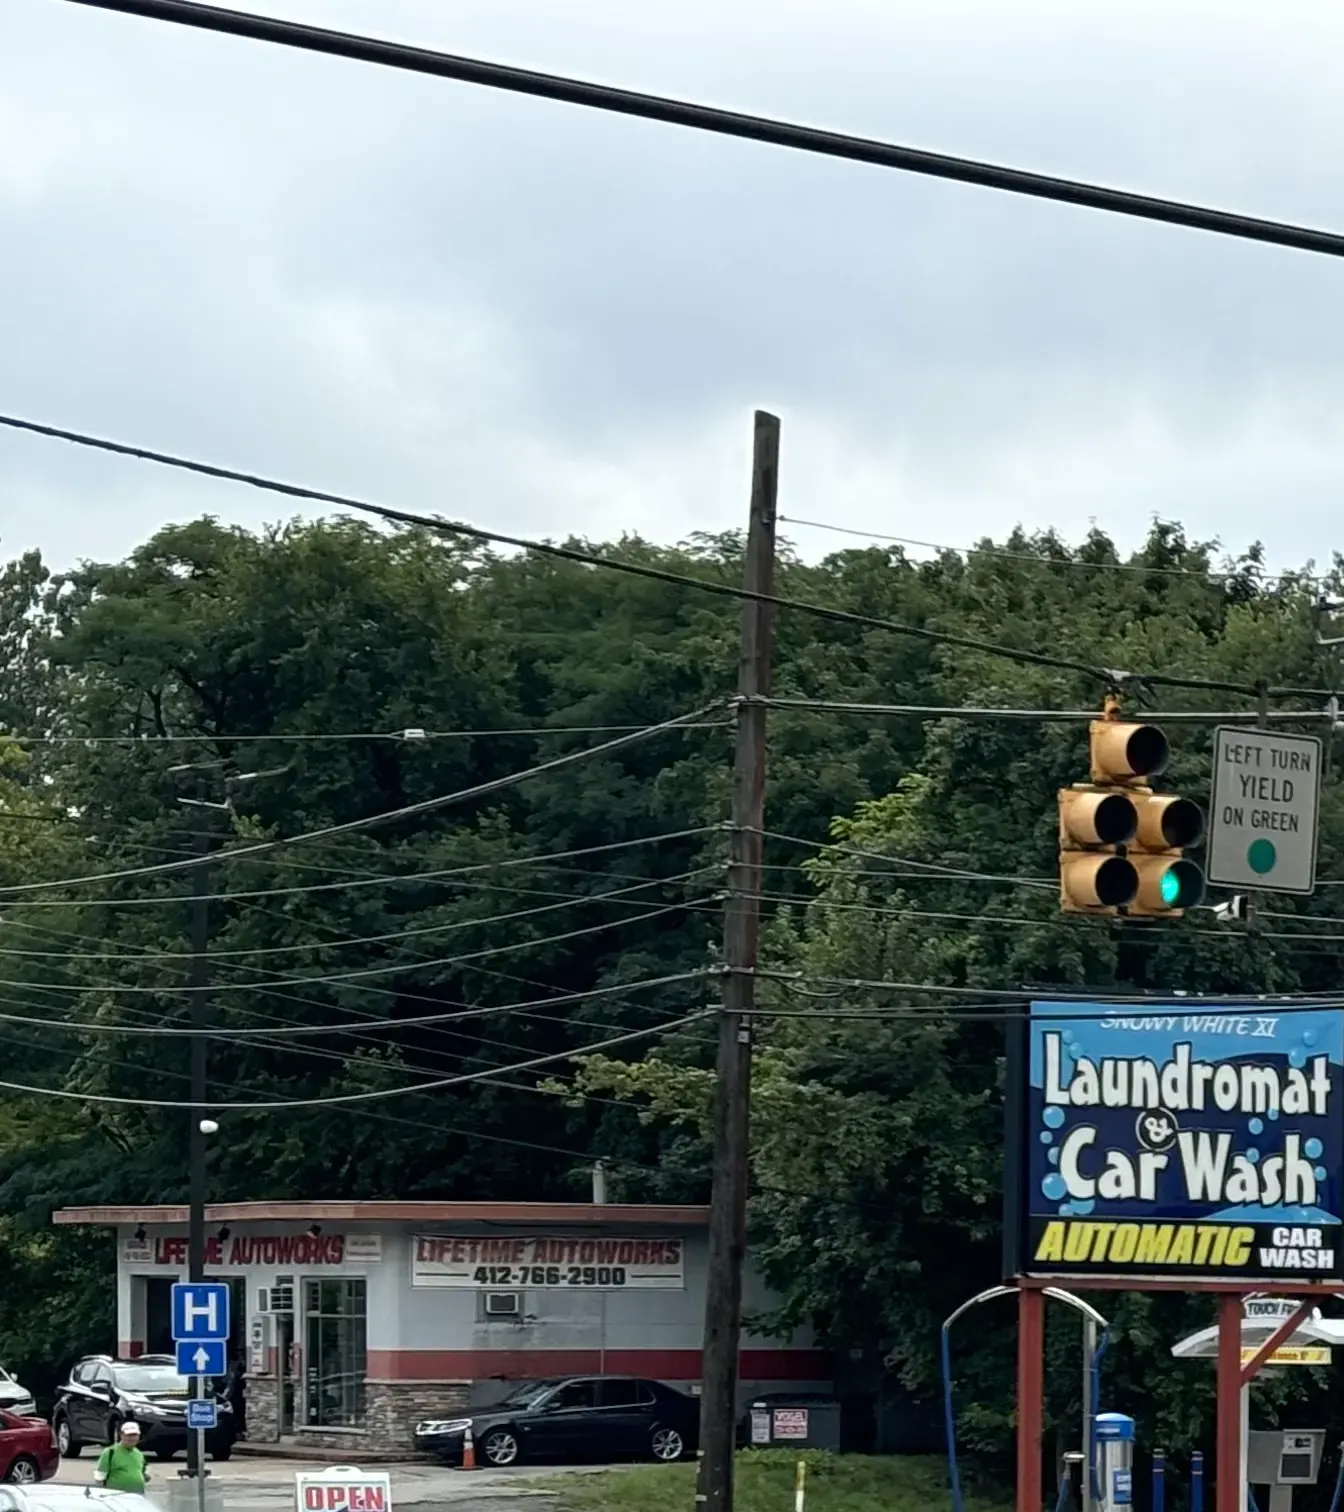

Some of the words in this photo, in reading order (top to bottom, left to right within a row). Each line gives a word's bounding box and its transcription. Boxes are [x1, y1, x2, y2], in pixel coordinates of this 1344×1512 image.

[1224, 743, 1263, 767] LEFT
[1270, 749, 1311, 772] TURN
[1240, 774, 1294, 802] YIELD
[1223, 806, 1244, 826] ON
[1251, 810, 1299, 832] GREEN
[1184, 1016, 1251, 1035] WHITE
[1044, 1032, 1331, 1115] Laundromat
[1059, 1126, 1169, 1200] Car
[1177, 1130, 1317, 1204] Wash
[229, 1235, 344, 1265] AUTOWORKS
[1034, 1221, 1256, 1266] AUTOMATIC
[1272, 1226, 1323, 1247] CAR
[416, 1238, 527, 1264] LIFETIME
[532, 1239, 681, 1265] AUTOWORKS
[1259, 1247, 1335, 1270] WASH
[473, 1266, 626, 1285] 412-766-2900
[184, 1292, 217, 1332] H
[305, 1486, 384, 1511] OPEN
